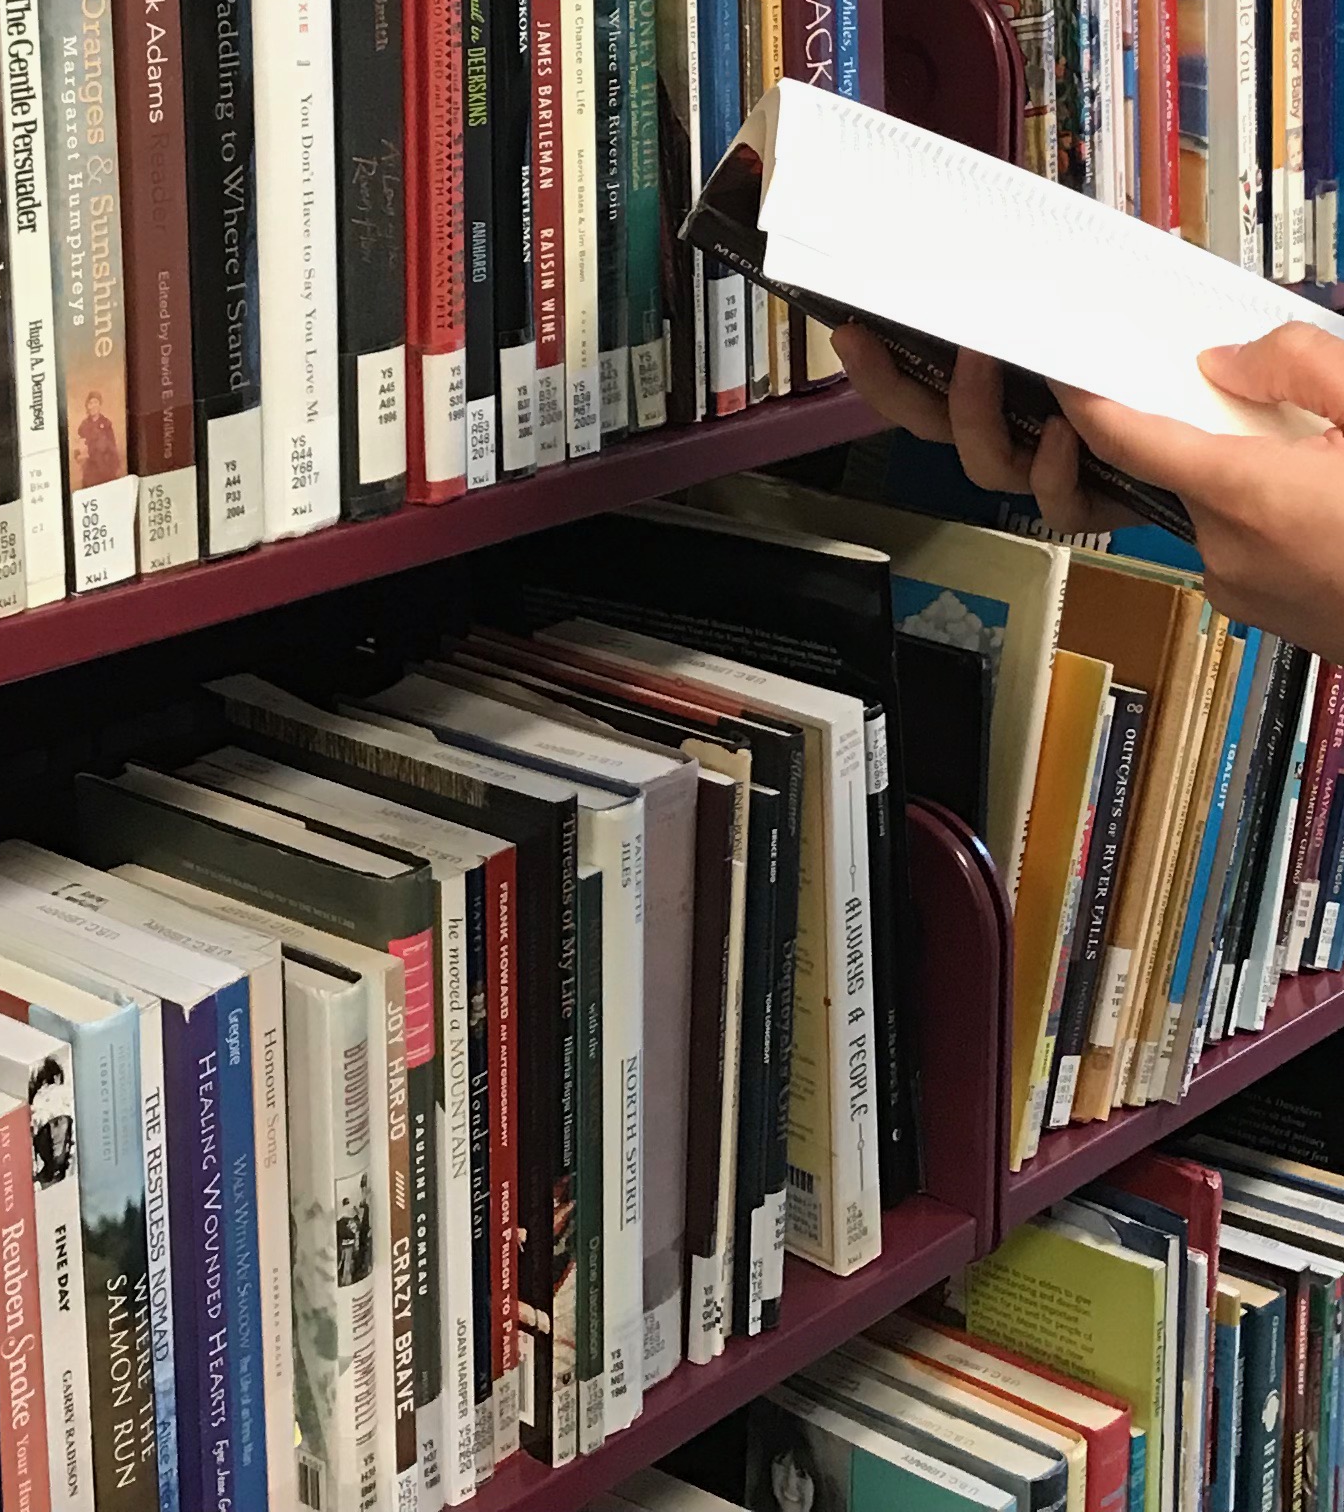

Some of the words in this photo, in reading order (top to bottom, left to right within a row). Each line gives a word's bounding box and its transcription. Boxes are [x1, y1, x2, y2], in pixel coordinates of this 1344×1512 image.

[8, 37, 34, 114] Gentle
[146, 22, 165, 124] Adams
[537, 21, 552, 77] JAMES
[13, 118, 36, 234] Persuader
[86, 155, 113, 186] &
[538, 85, 553, 190] BARTLEMAN
[89, 193, 116, 358] Sunshine
[540, 228, 554, 290] RAISIN
[541, 298, 556, 344] WINE
[1112, 728, 1137, 818] OUTCASTS
[1098, 844, 1117, 899] RIVER
[845, 897, 865, 998] ALWAYS
[1085, 905, 1106, 962] FALLS
[386, 1001, 405, 1048] JOY
[197, 1051, 218, 1171] HEALING
[388, 1055, 407, 1142] HARJO
[850, 1032, 869, 1123] PEOPLE
[1, 1218, 29, 1332] Reuben
[201, 1172, 224, 1320] WOUNDED
[392, 1236, 412, 1321] CRAZY
[2, 1332, 36, 1430] Snake
[106, 1274, 132, 1409] SALMON
[207, 1326, 228, 1430] HEARTS
[394, 1330, 414, 1421] BRAVE
[113, 1422, 137, 1490] RUN
